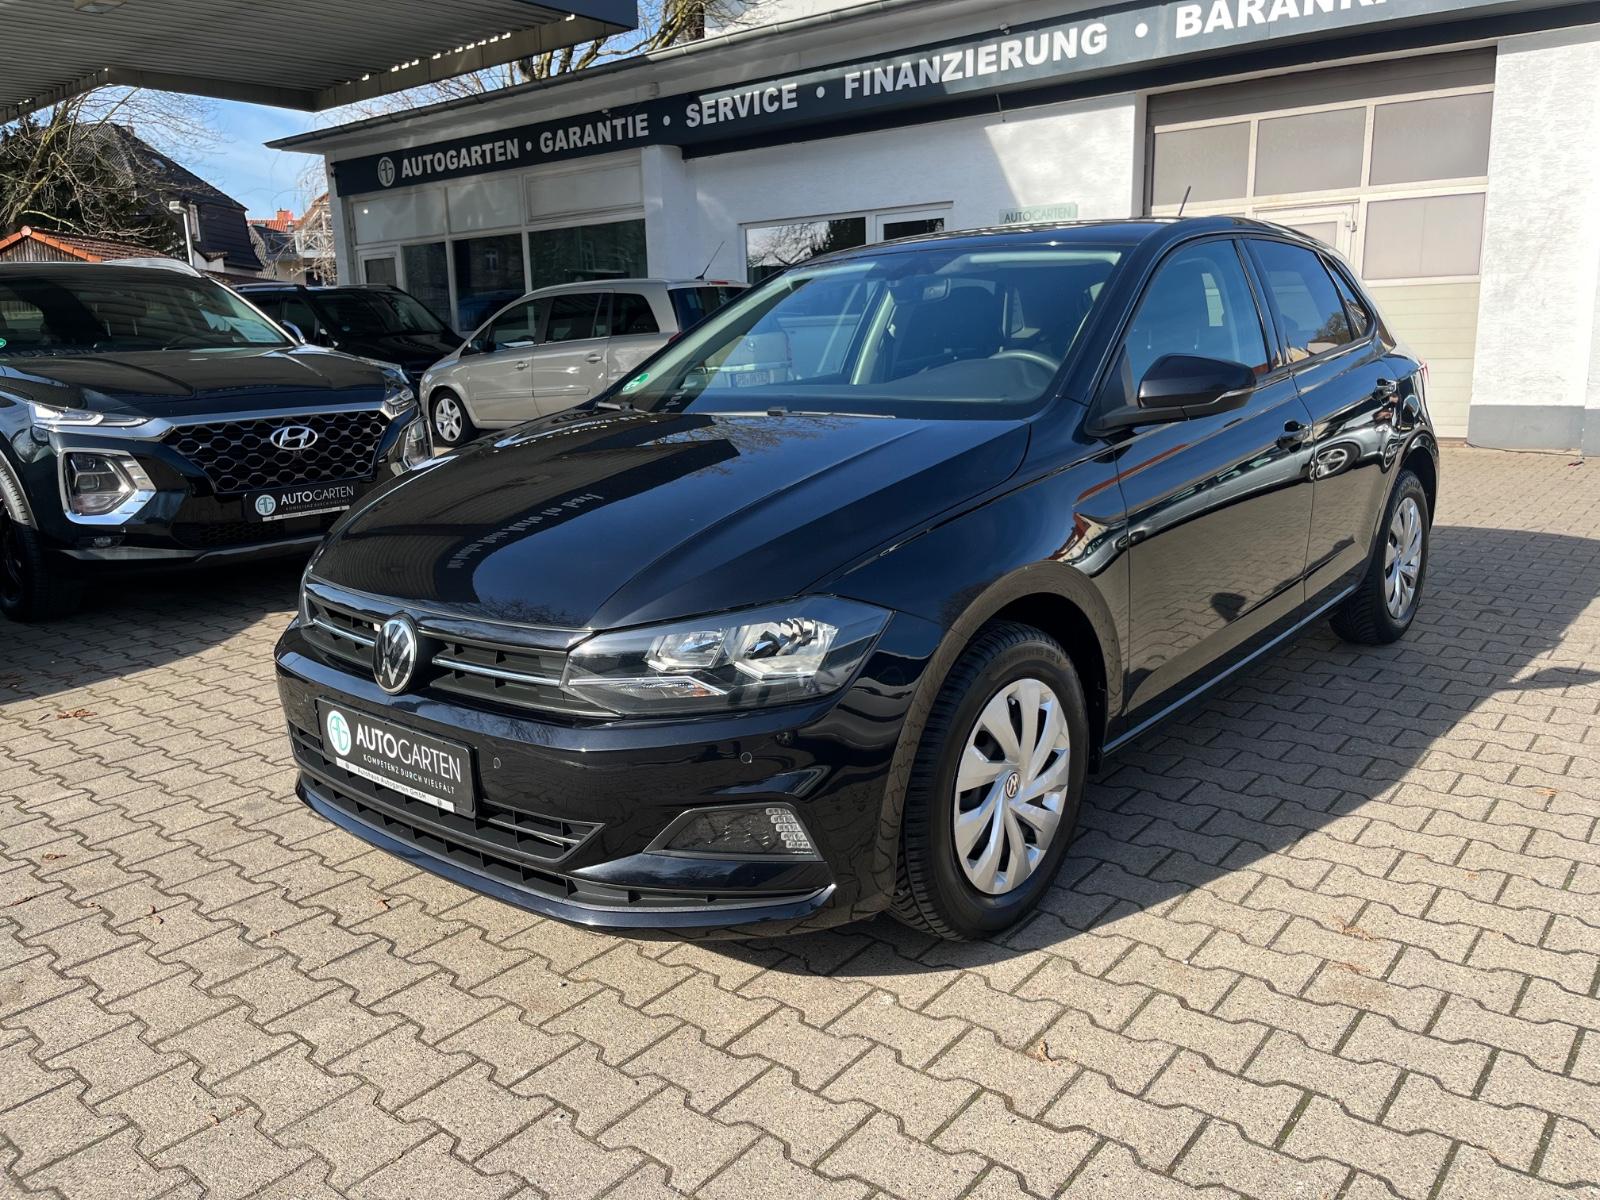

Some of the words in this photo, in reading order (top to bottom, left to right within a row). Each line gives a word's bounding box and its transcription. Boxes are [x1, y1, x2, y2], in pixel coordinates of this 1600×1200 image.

[401, 138, 520, 179] AUTOGARTEN
[539, 113, 649, 154] GARANTIE
[685, 83, 798, 128] SERVICE
[843, 23, 1107, 100] FINANZIERUNG
[1004, 207, 1072, 224] AUTOGARTEN
[280, 486, 354, 505] AUTOGARTEN
[356, 723, 461, 783] AUTOGARTEN
[363, 754, 400, 774] KOMPETENZ
[400, 768, 423, 783] DURCH
